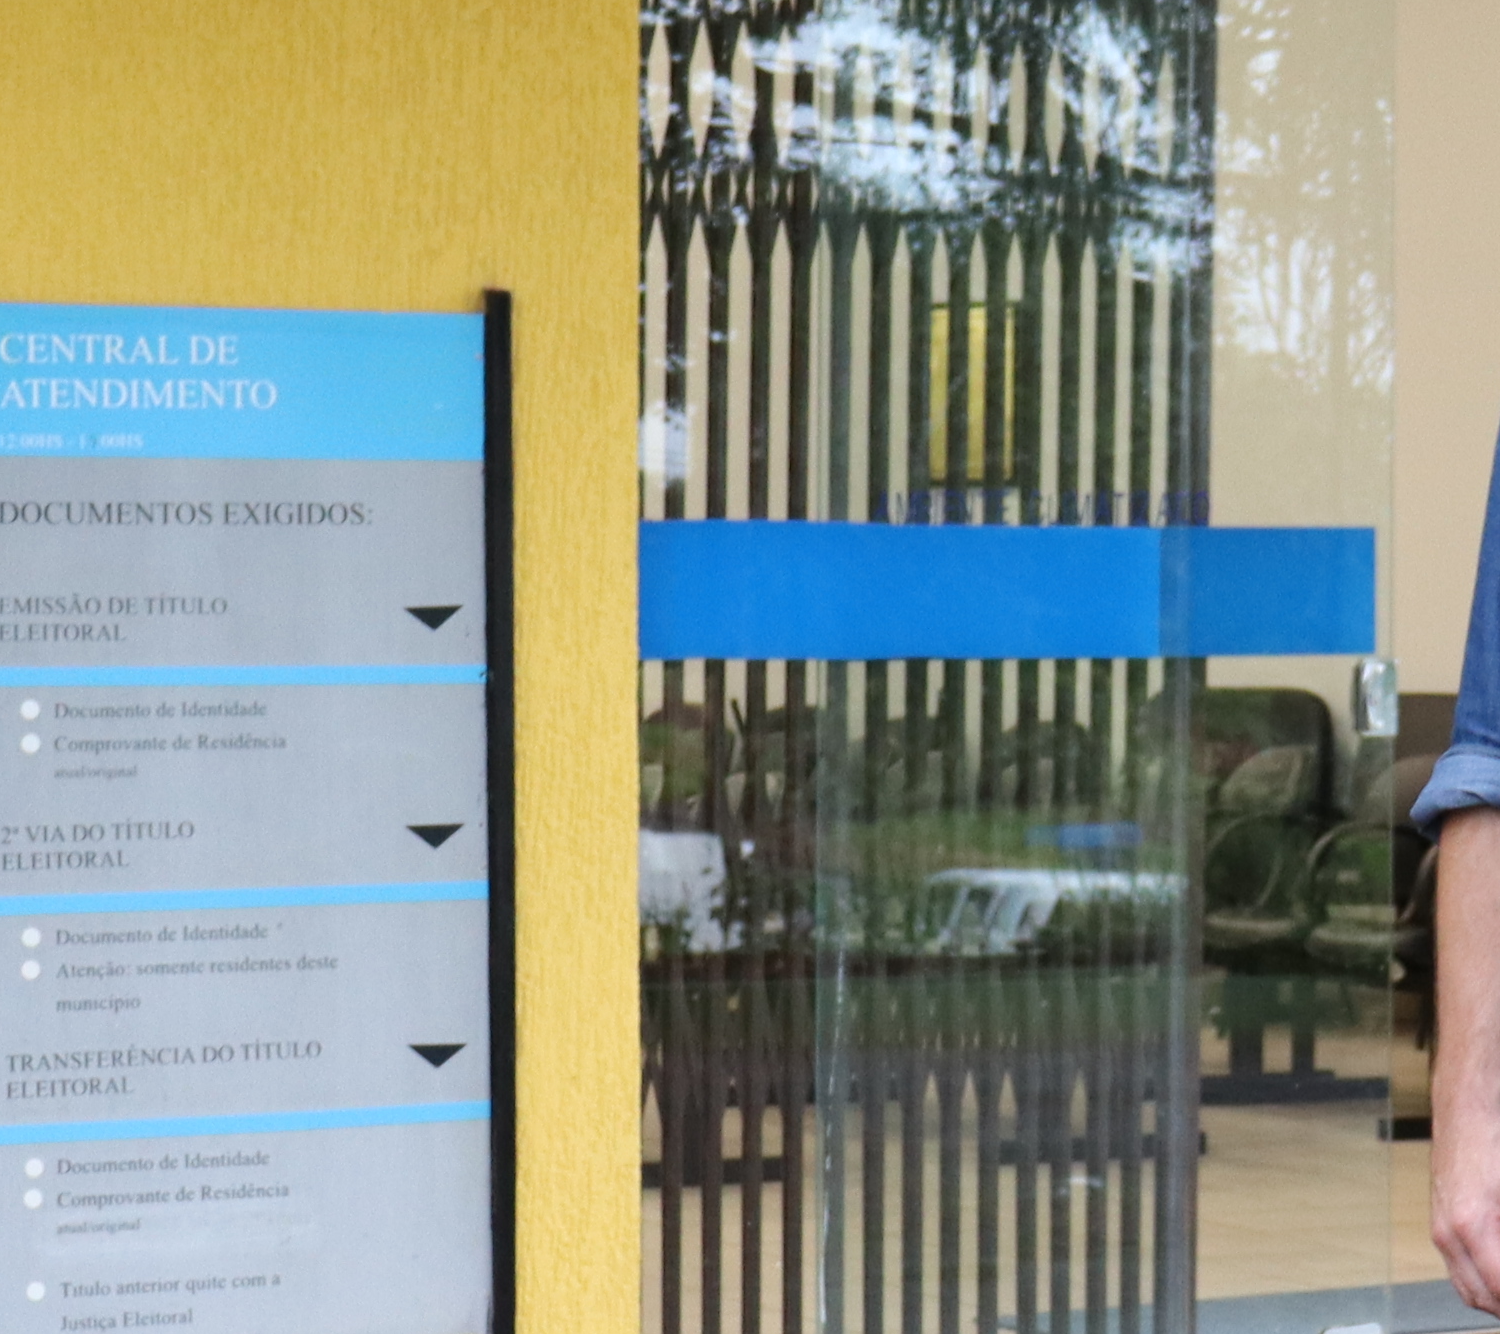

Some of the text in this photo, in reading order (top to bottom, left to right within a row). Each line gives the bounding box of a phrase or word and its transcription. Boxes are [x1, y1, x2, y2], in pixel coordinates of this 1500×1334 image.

[0, 334, 238, 366] CENTRAL DE
[0, 377, 278, 409] ATENDIMENTO
[0, 502, 374, 525] DOCUMENTOS EXIGIDOS:
[0, 593, 228, 616] EMISSÃO DE TÍTULO
[0, 623, 126, 643] ELEITORAL
[54, 701, 267, 719] Documento de Identidade
[54, 732, 287, 754] Comprovante de Residência
[26, 826, 65, 843] VIA
[71, 824, 105, 841] DO
[110, 819, 195, 840] TÍTULO
[1, 850, 130, 872] ELEITORAL
[55, 923, 268, 945] Documento de Identidade
[136, 960, 204, 975] somente
[209, 955, 292, 973] residentes
[297, 954, 338, 971] deste
[7, 1038, 323, 1073] TRANSFERÊNCIA DO TÍTULO
[6, 1076, 134, 1099] ELEITORAL
[56, 1151, 271, 1175] Documento de Identidade
[56, 1188, 170, 1211] Comprovante
[174, 1187, 195, 1202] de
[116, 1276, 181, 1294] anterior
[185, 1275, 227, 1296] quite
[232, 1276, 267, 1290] com
[271, 1275, 281, 1288] a
[60, 1308, 194, 1333] Justiça Eleitoral
